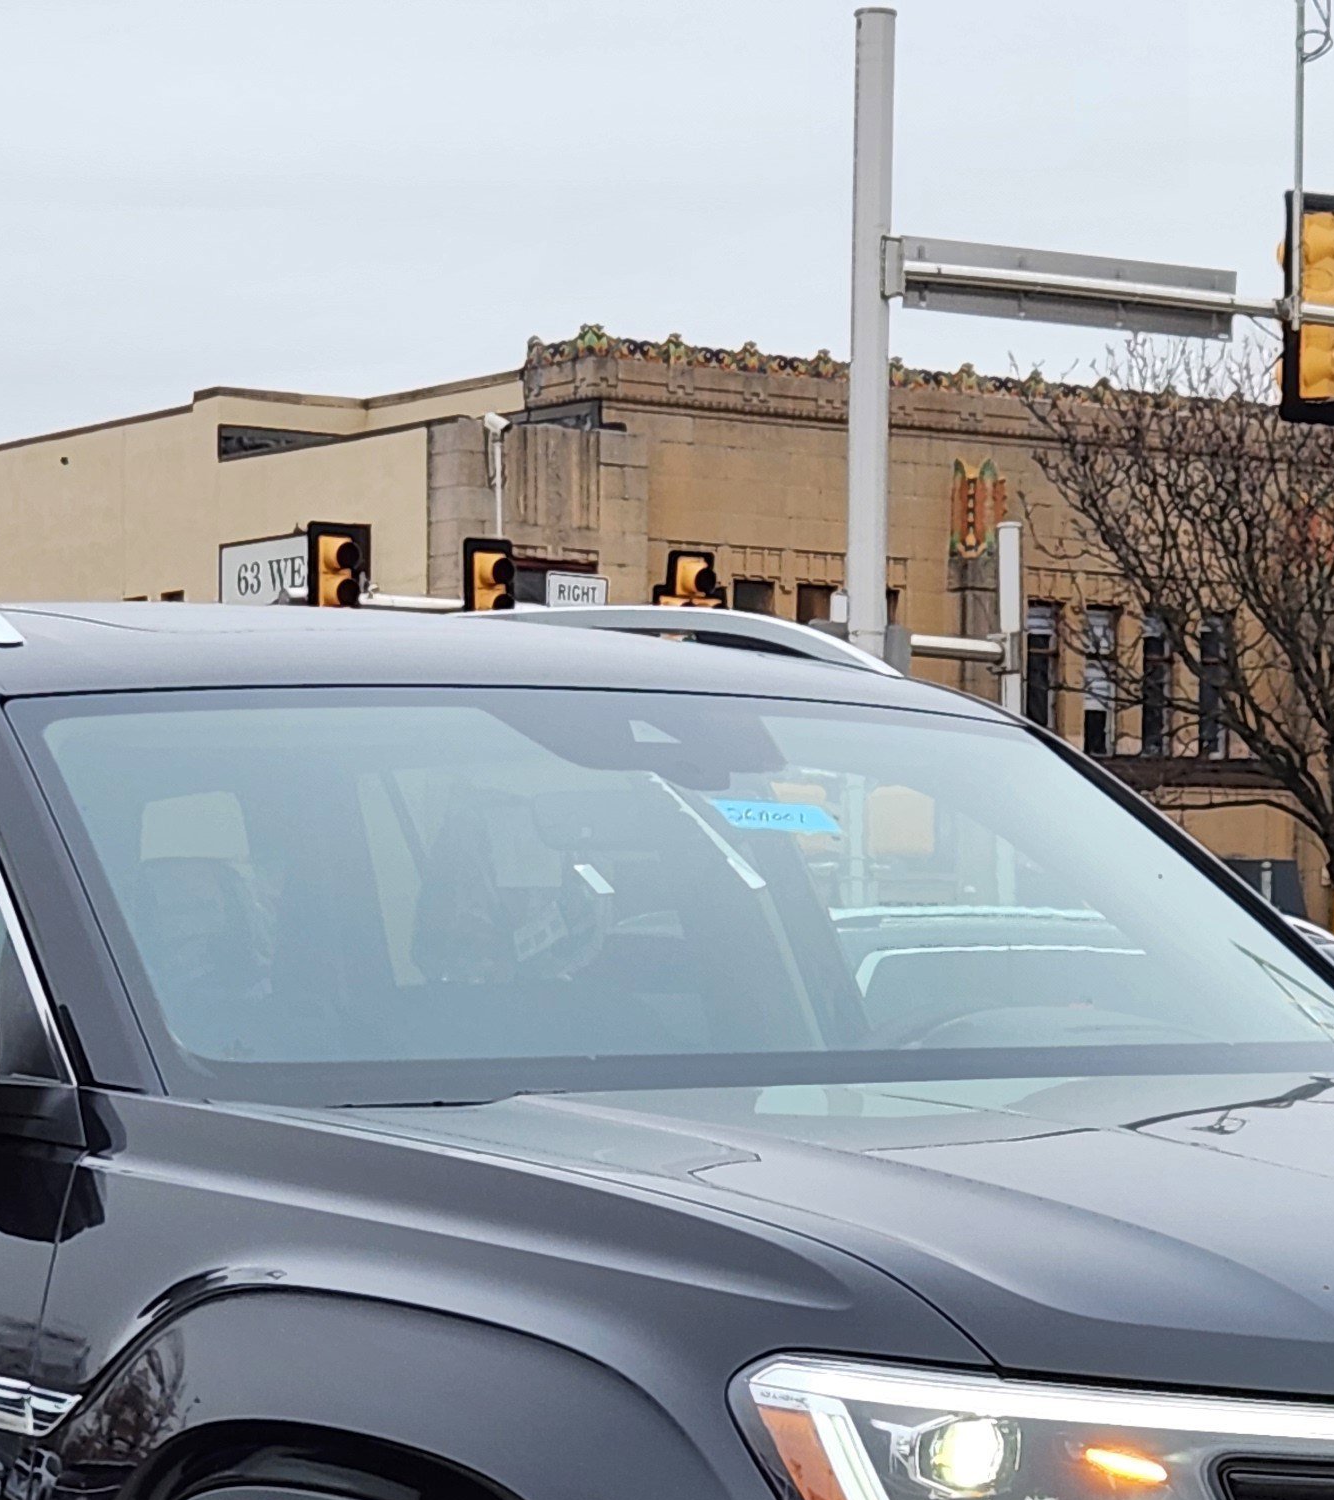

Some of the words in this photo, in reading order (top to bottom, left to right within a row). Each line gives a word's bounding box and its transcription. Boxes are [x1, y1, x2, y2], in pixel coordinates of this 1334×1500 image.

[237, 561, 262, 596] 63
[268, 555, 306, 592] WE
[558, 583, 598, 604] RIGHT
